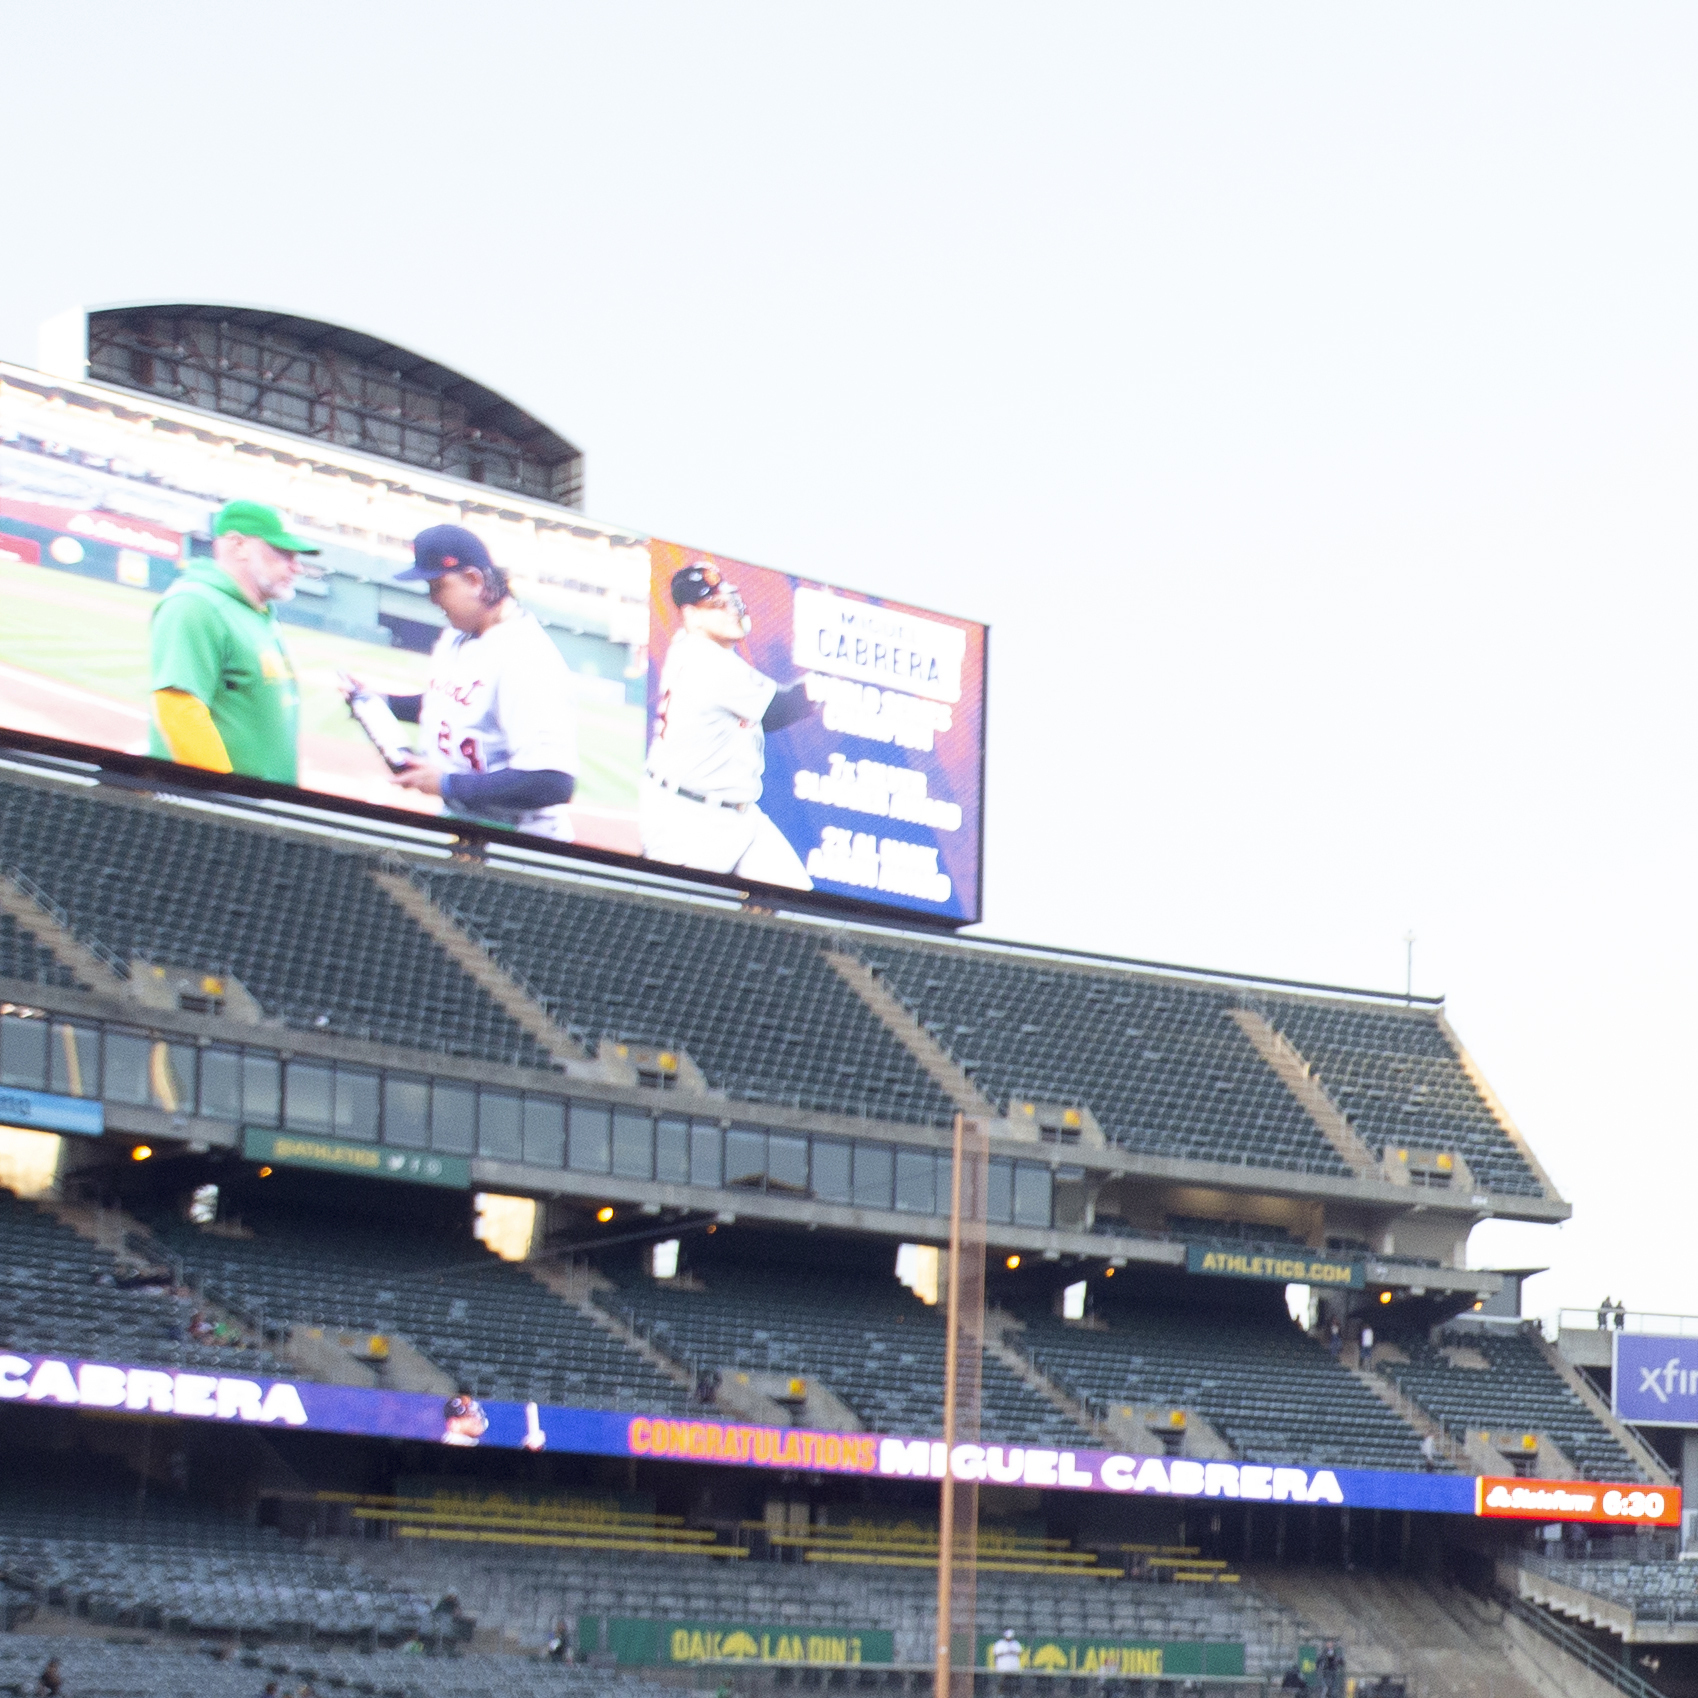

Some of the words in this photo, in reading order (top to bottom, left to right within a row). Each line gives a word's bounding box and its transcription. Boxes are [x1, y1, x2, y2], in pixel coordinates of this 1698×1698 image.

[818, 628, 940, 684] CABRERA
[1202, 1252, 1352, 1283] ATHLETICS.COM
[0, 1354, 309, 1426] CABRERA
[628, 1416, 877, 1473] CONGRATULATIONS
[879, 1438, 1093, 1488] MIGUEL
[1099, 1454, 1345, 1504] CABRERA
[1602, 1490, 1665, 1518] 6:30
